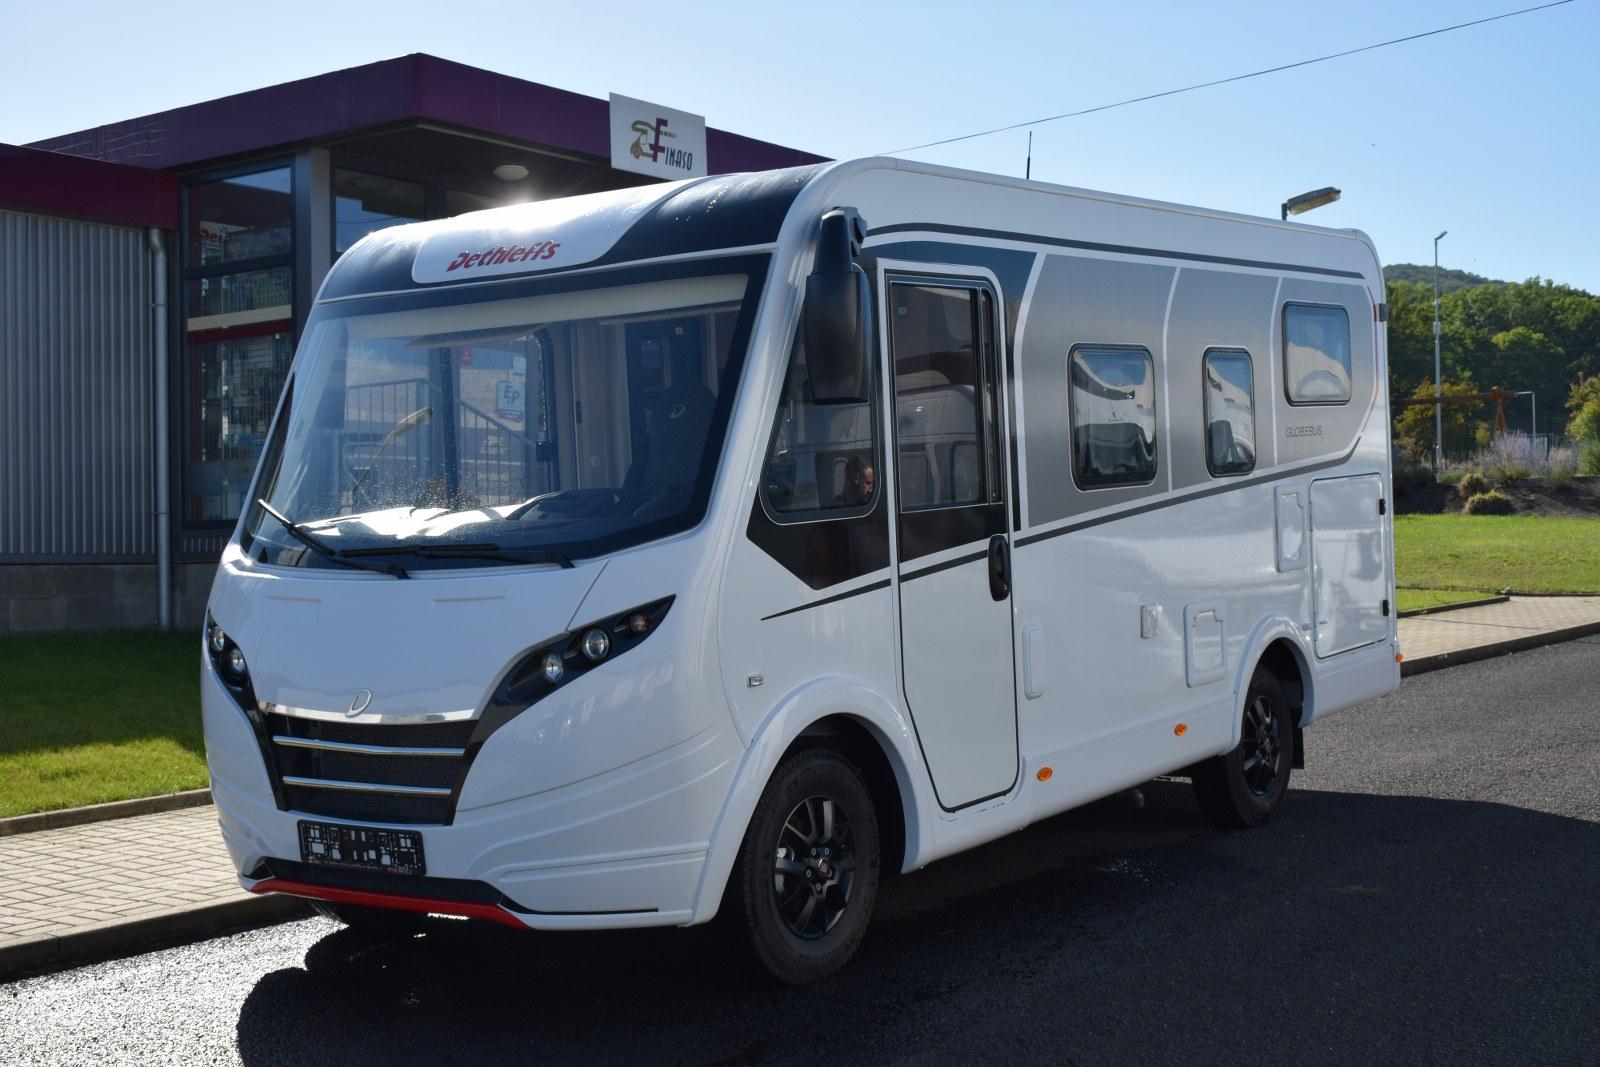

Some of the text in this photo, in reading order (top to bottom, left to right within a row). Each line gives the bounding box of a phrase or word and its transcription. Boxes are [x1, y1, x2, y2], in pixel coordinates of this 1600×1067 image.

[648, 117, 693, 171] FINASO
[446, 240, 561, 272] Dethleffs
[1285, 425, 1323, 438] GLOBEBUS
